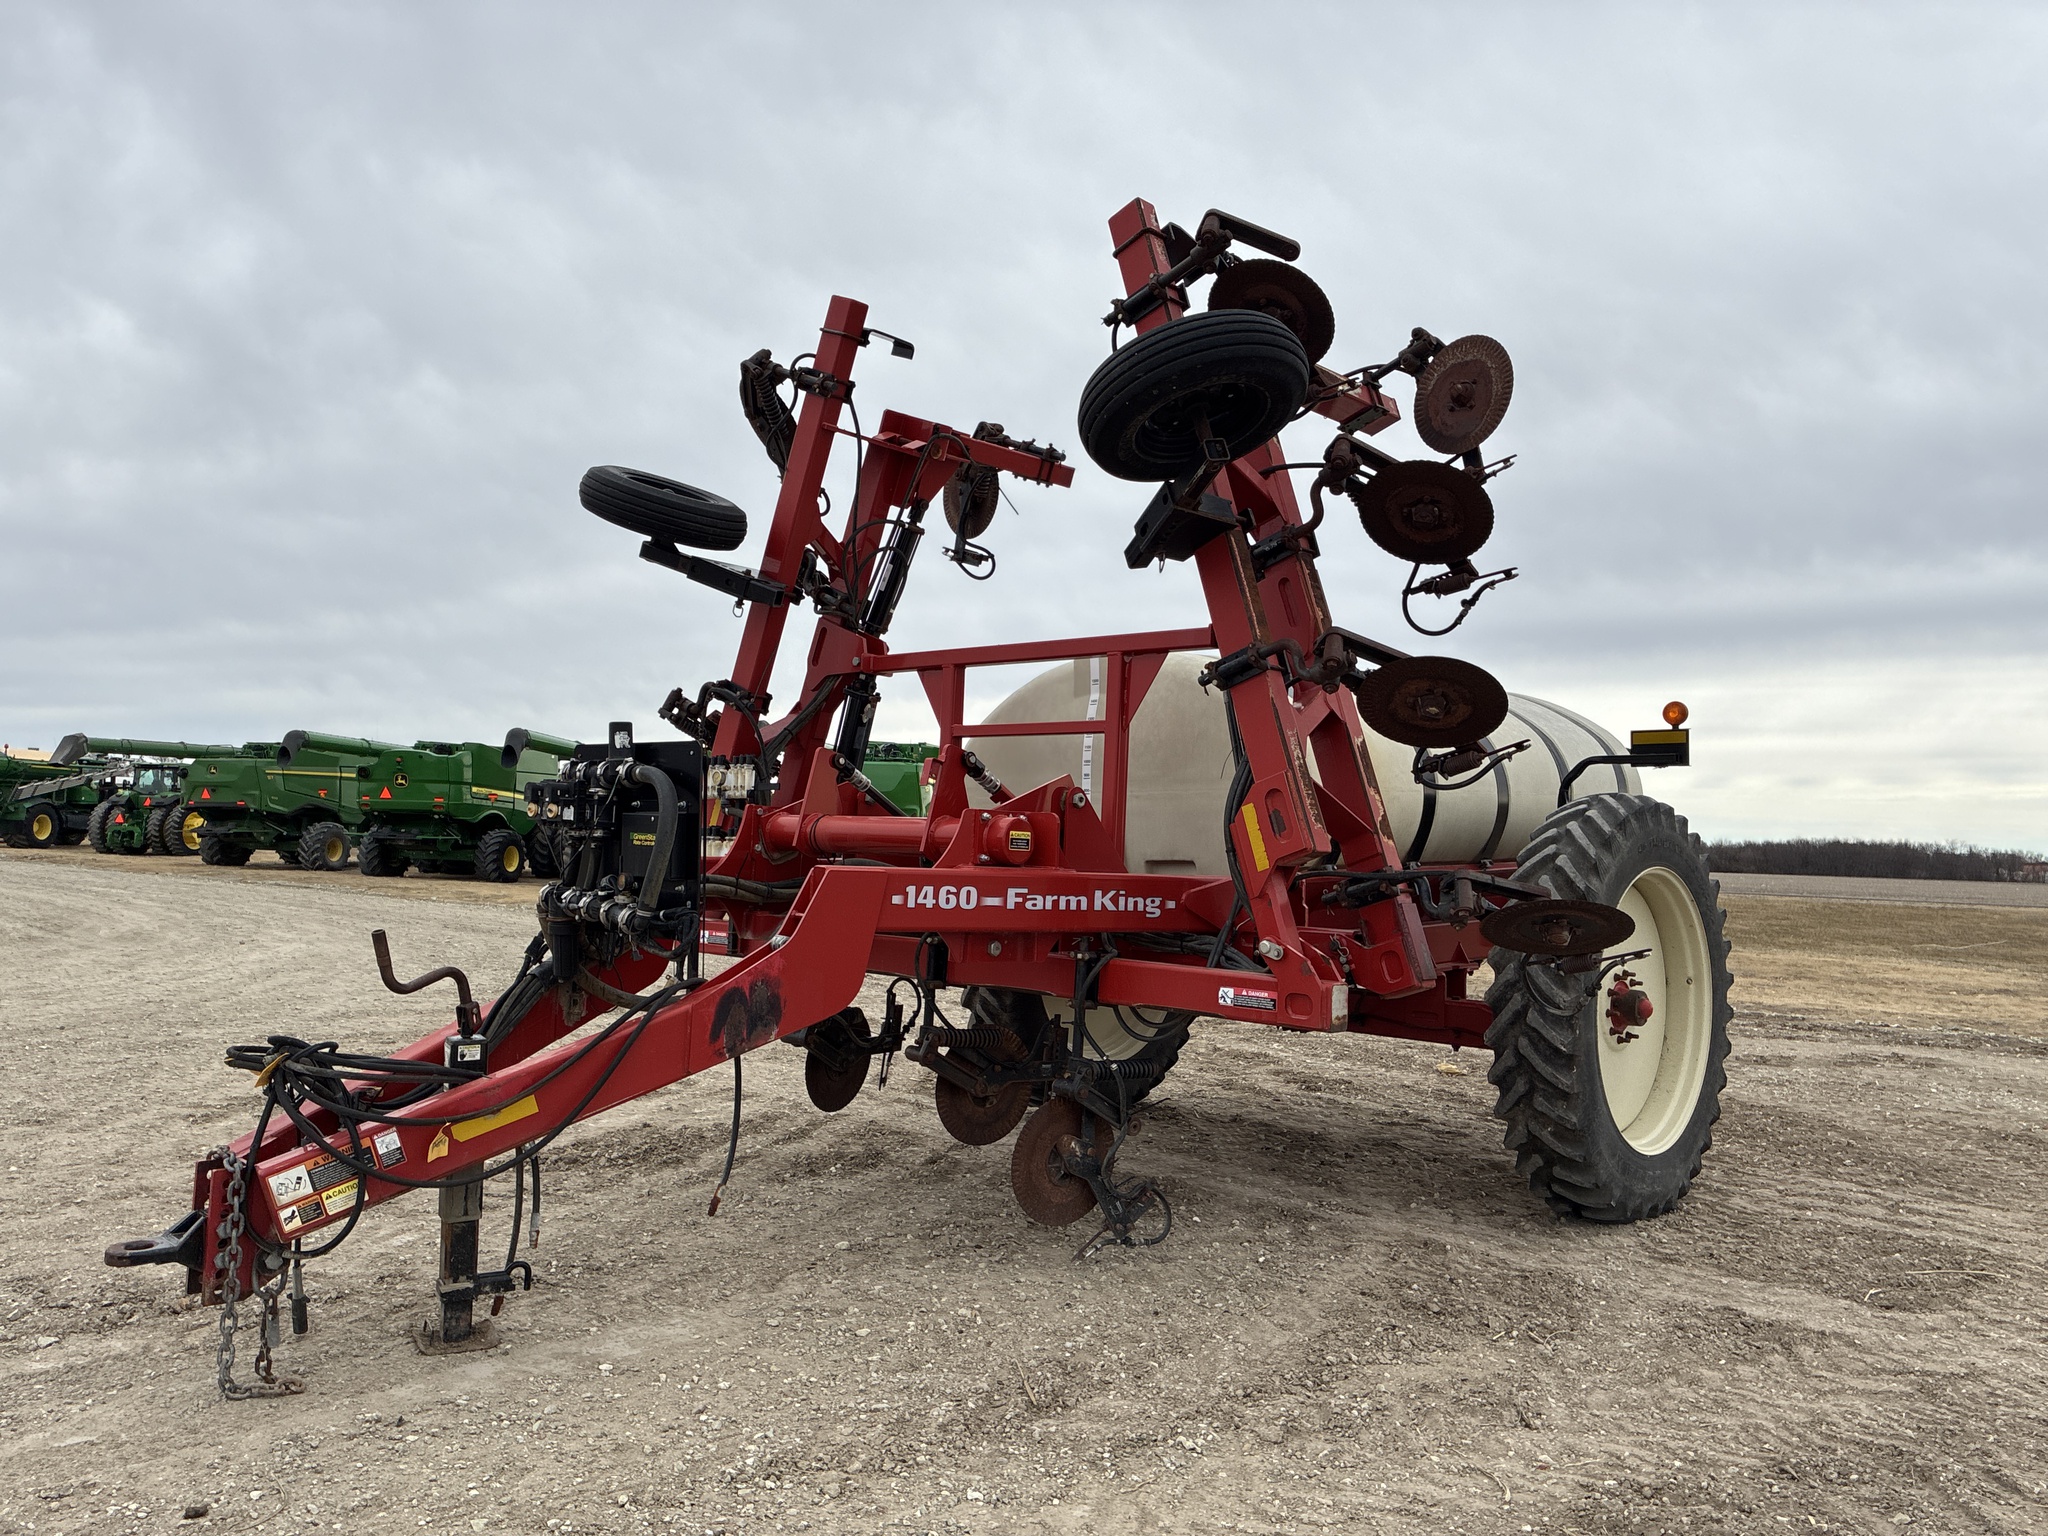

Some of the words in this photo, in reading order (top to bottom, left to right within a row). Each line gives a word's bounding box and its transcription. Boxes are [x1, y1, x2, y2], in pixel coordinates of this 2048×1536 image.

[633, 833, 656, 841] GreenSta
[905, 885, 978, 910] 1460
[1006, 887, 1088, 911] Farm
[1094, 889, 1162, 918] King
[378, 1127, 397, 1138] DANGER
[332, 1182, 359, 1198] CAUTIO
